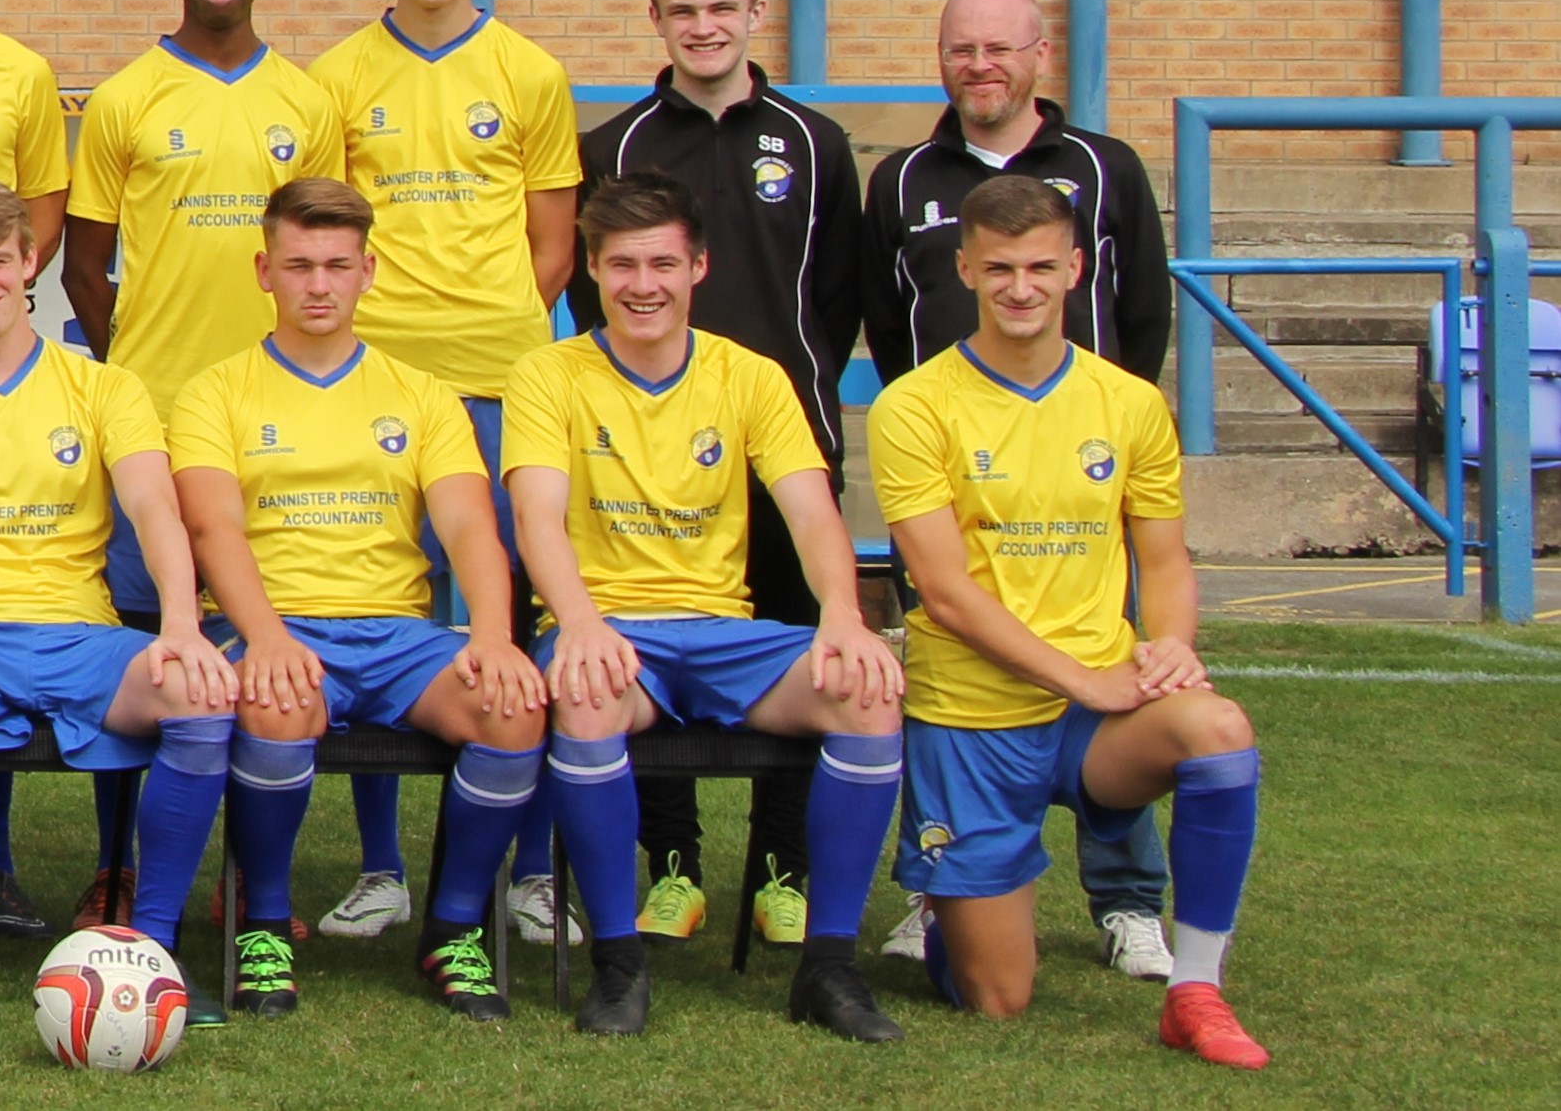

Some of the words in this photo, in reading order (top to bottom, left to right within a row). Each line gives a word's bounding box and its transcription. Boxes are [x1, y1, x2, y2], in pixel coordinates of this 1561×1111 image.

[758, 134, 785, 153] SB
[373, 170, 434, 187] BANNISTER
[241, 194, 271, 207] PREN
[390, 189, 475, 204] ACCOUNTANTS
[187, 214, 263, 227] ACCOUNTAN
[258, 492, 336, 509] BANNISTER
[589, 497, 660, 517] BANNISTER
[665, 504, 722, 521] PRENTICE
[282, 511, 383, 526] ACCOUNTANTS
[609, 521, 703, 539] ACCOUNTANTS
[88, 946, 162, 973] mitre
